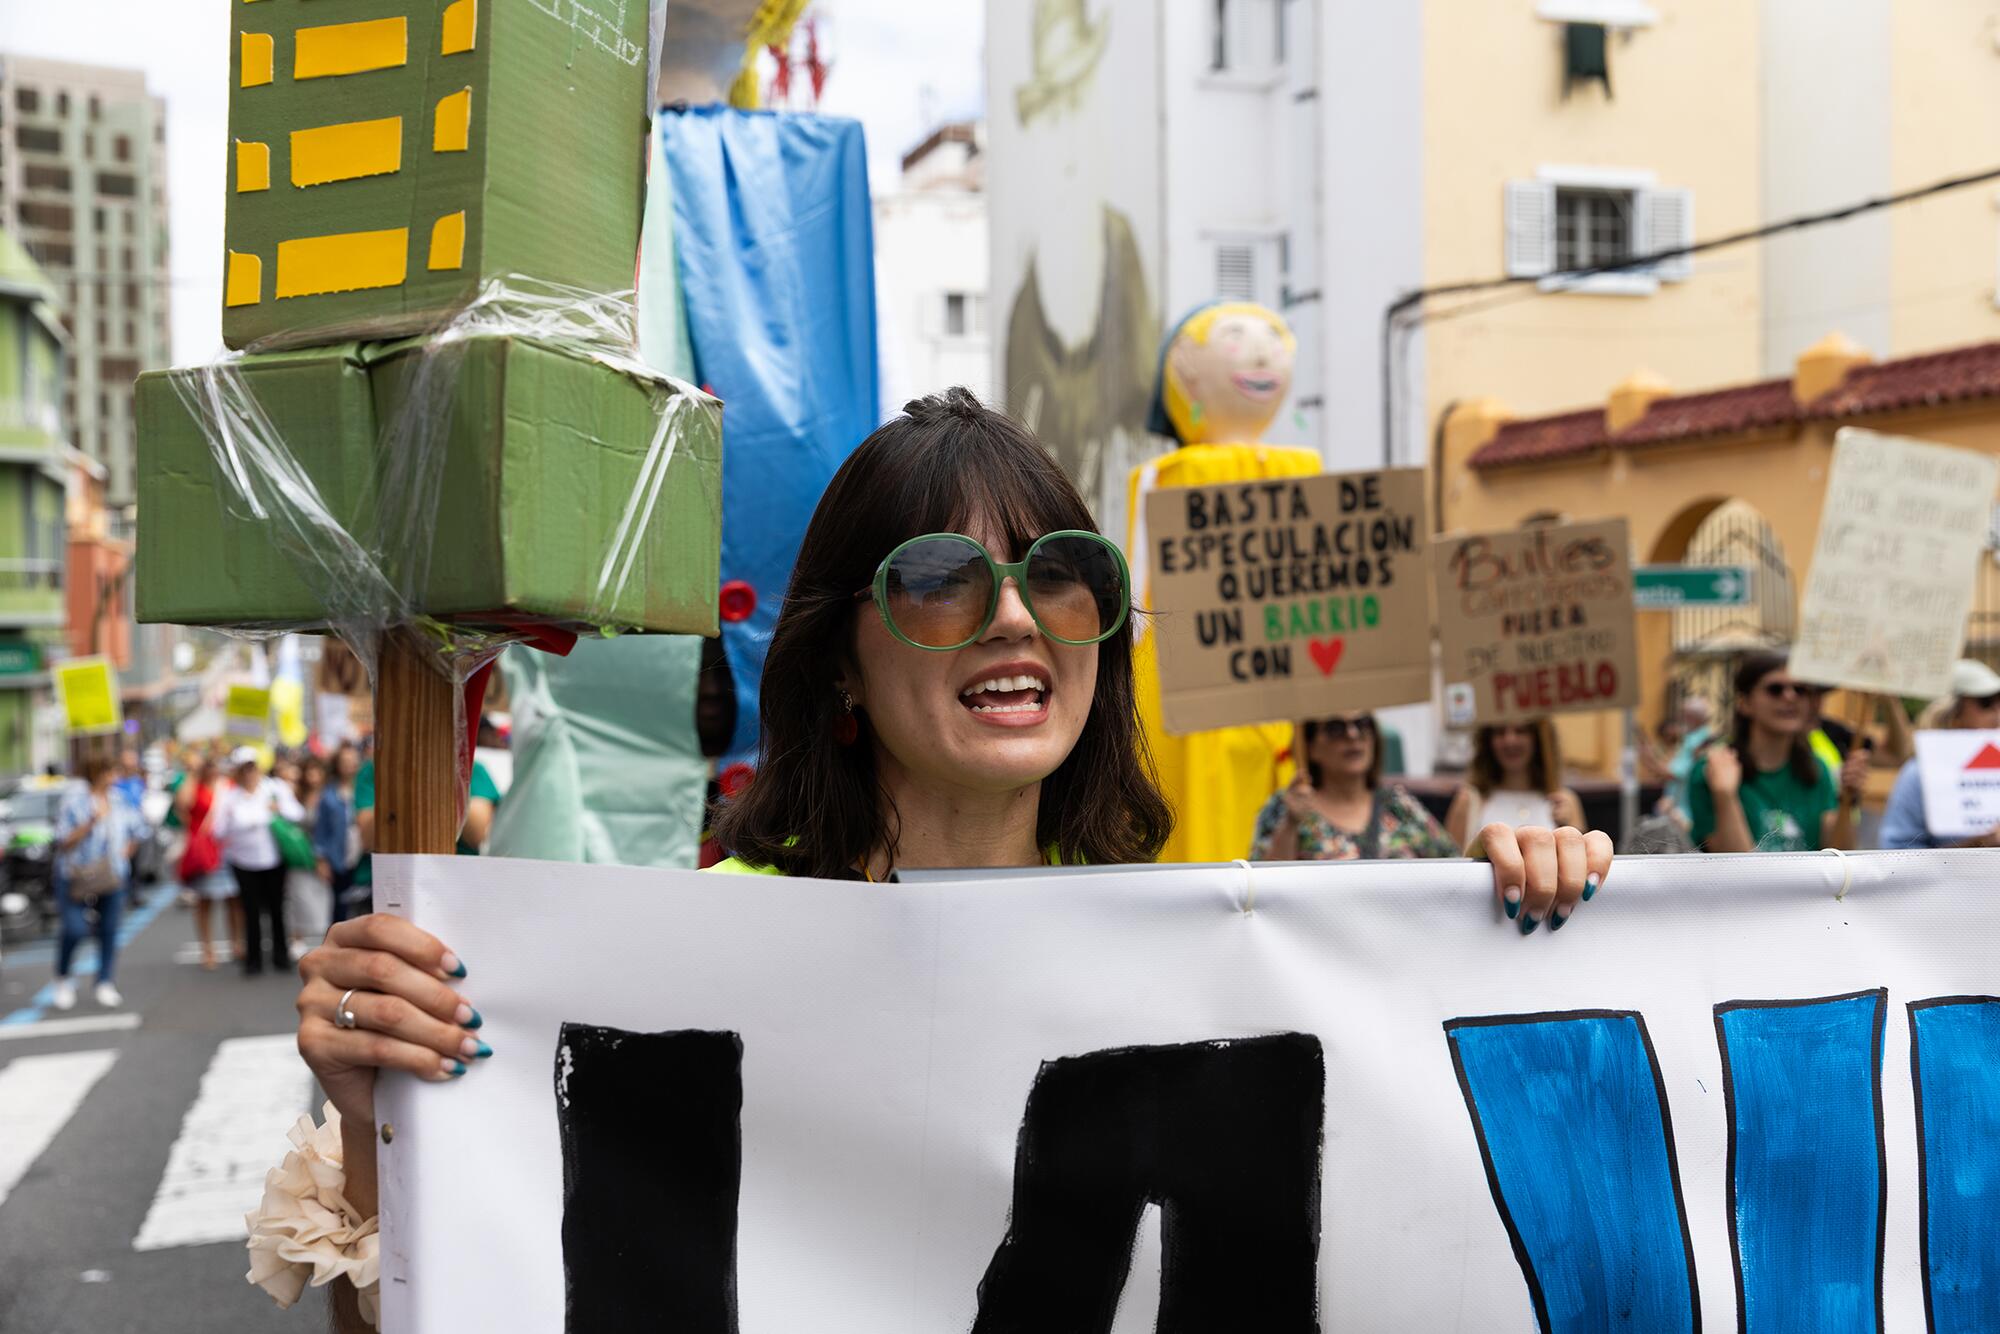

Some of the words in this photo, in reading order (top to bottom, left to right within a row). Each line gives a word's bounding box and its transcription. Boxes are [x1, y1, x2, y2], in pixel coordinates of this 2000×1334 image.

[1187, 484, 1309, 531] BASTA
[1339, 477, 1381, 514] DE
[1219, 557, 1394, 602] QUEREMOS
[1195, 608, 1244, 646] UN
[1264, 594, 1380, 641] BARRIO
[1230, 646, 1292, 681] CON
[1493, 659, 1618, 714] PUEBLO
